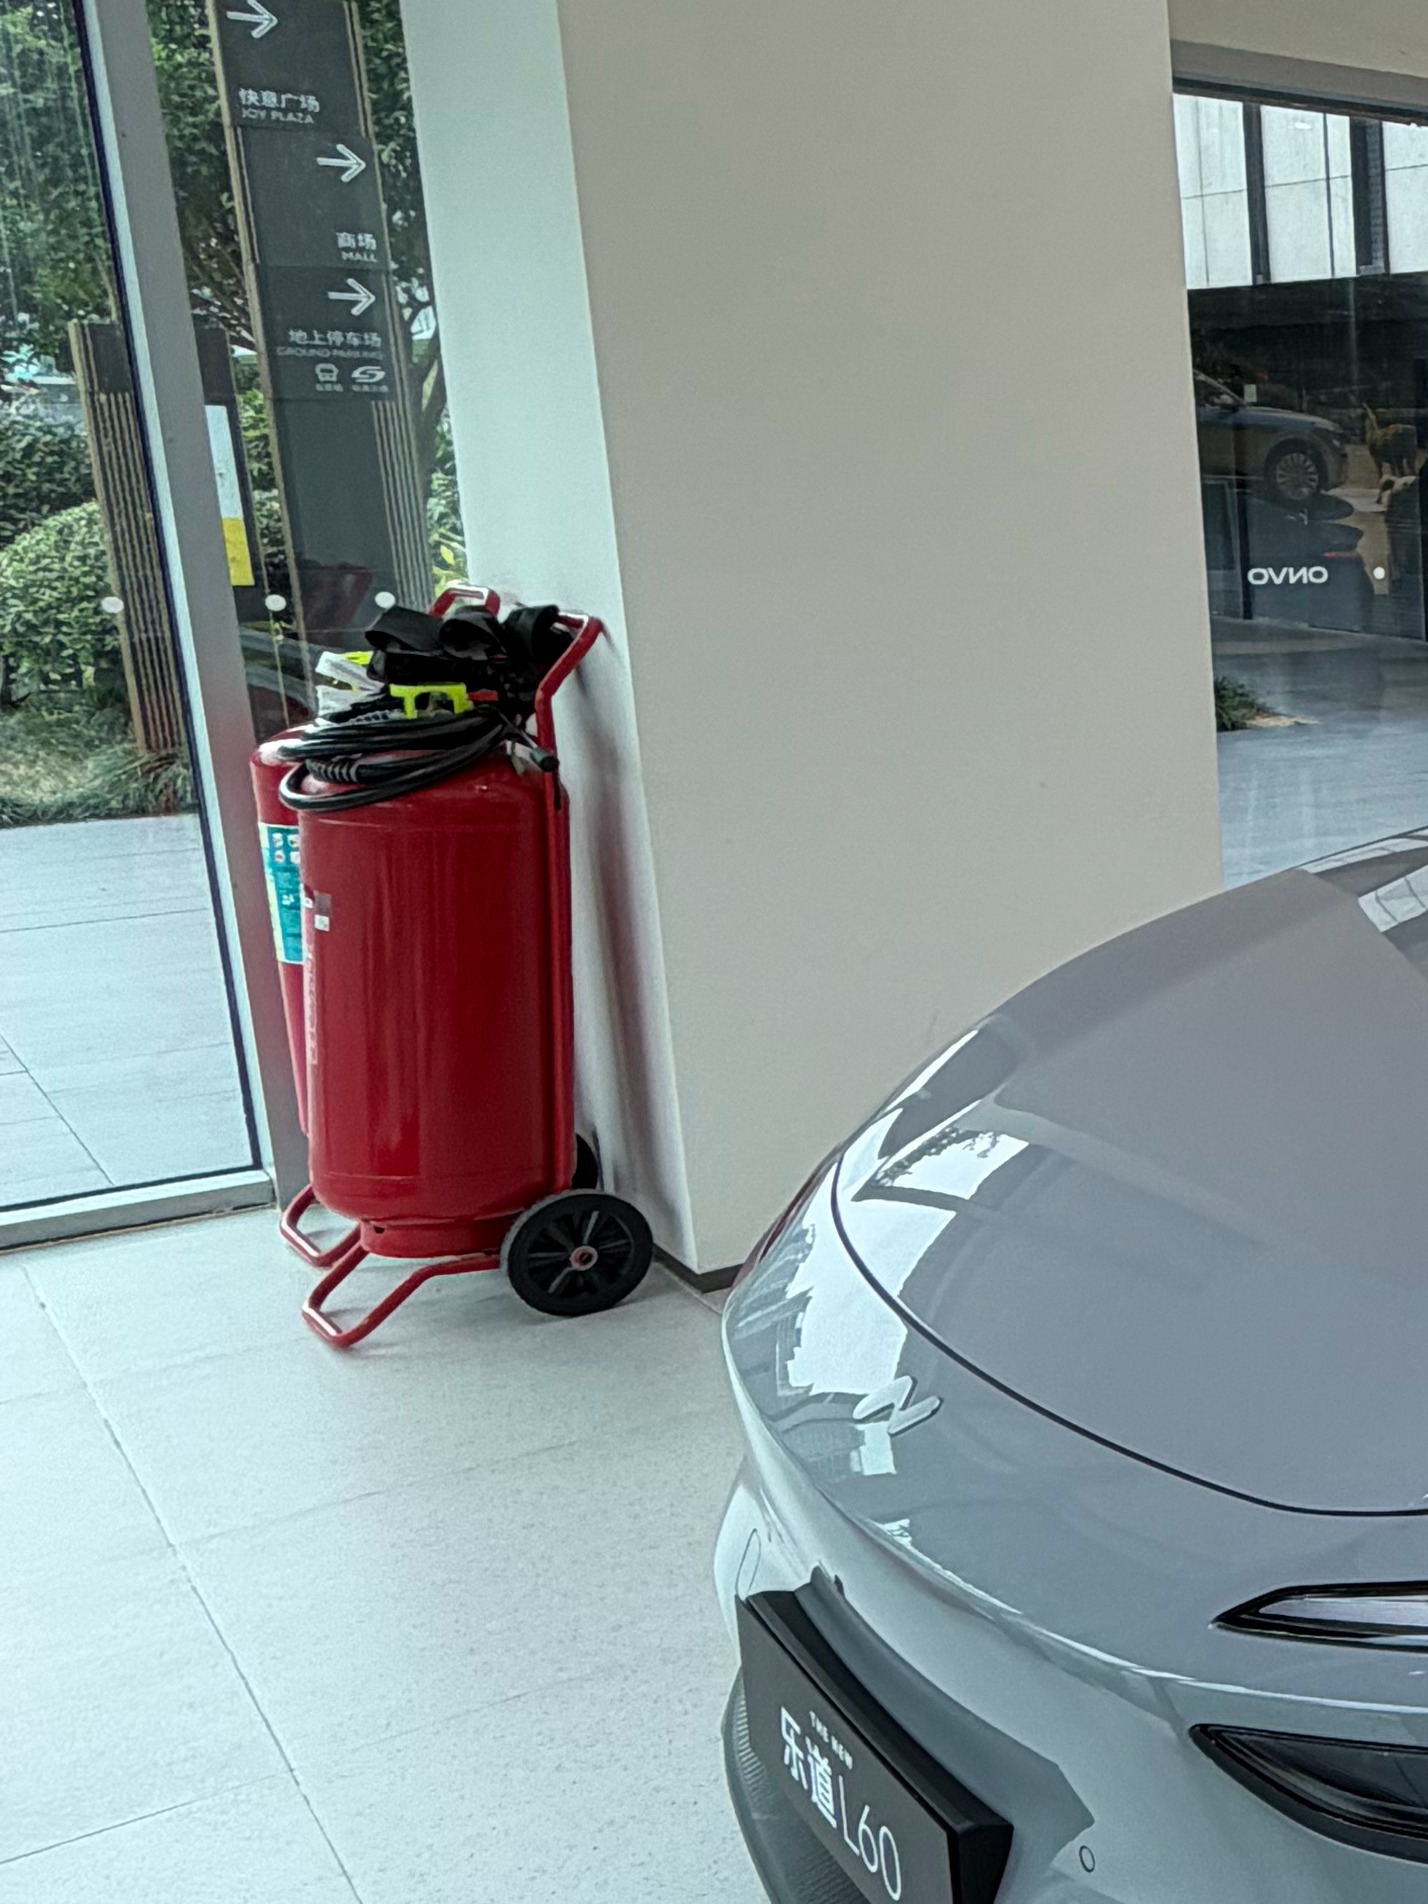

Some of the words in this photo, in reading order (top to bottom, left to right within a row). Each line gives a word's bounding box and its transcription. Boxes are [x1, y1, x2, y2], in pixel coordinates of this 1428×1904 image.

[241, 107, 267, 120] JOY
[270, 110, 315, 124] PLAZA
[335, 231, 377, 250] 商场
[341, 251, 379, 262] MALL
[809, 1710, 830, 1743] THE
[831, 1735, 853, 1770] NEW
